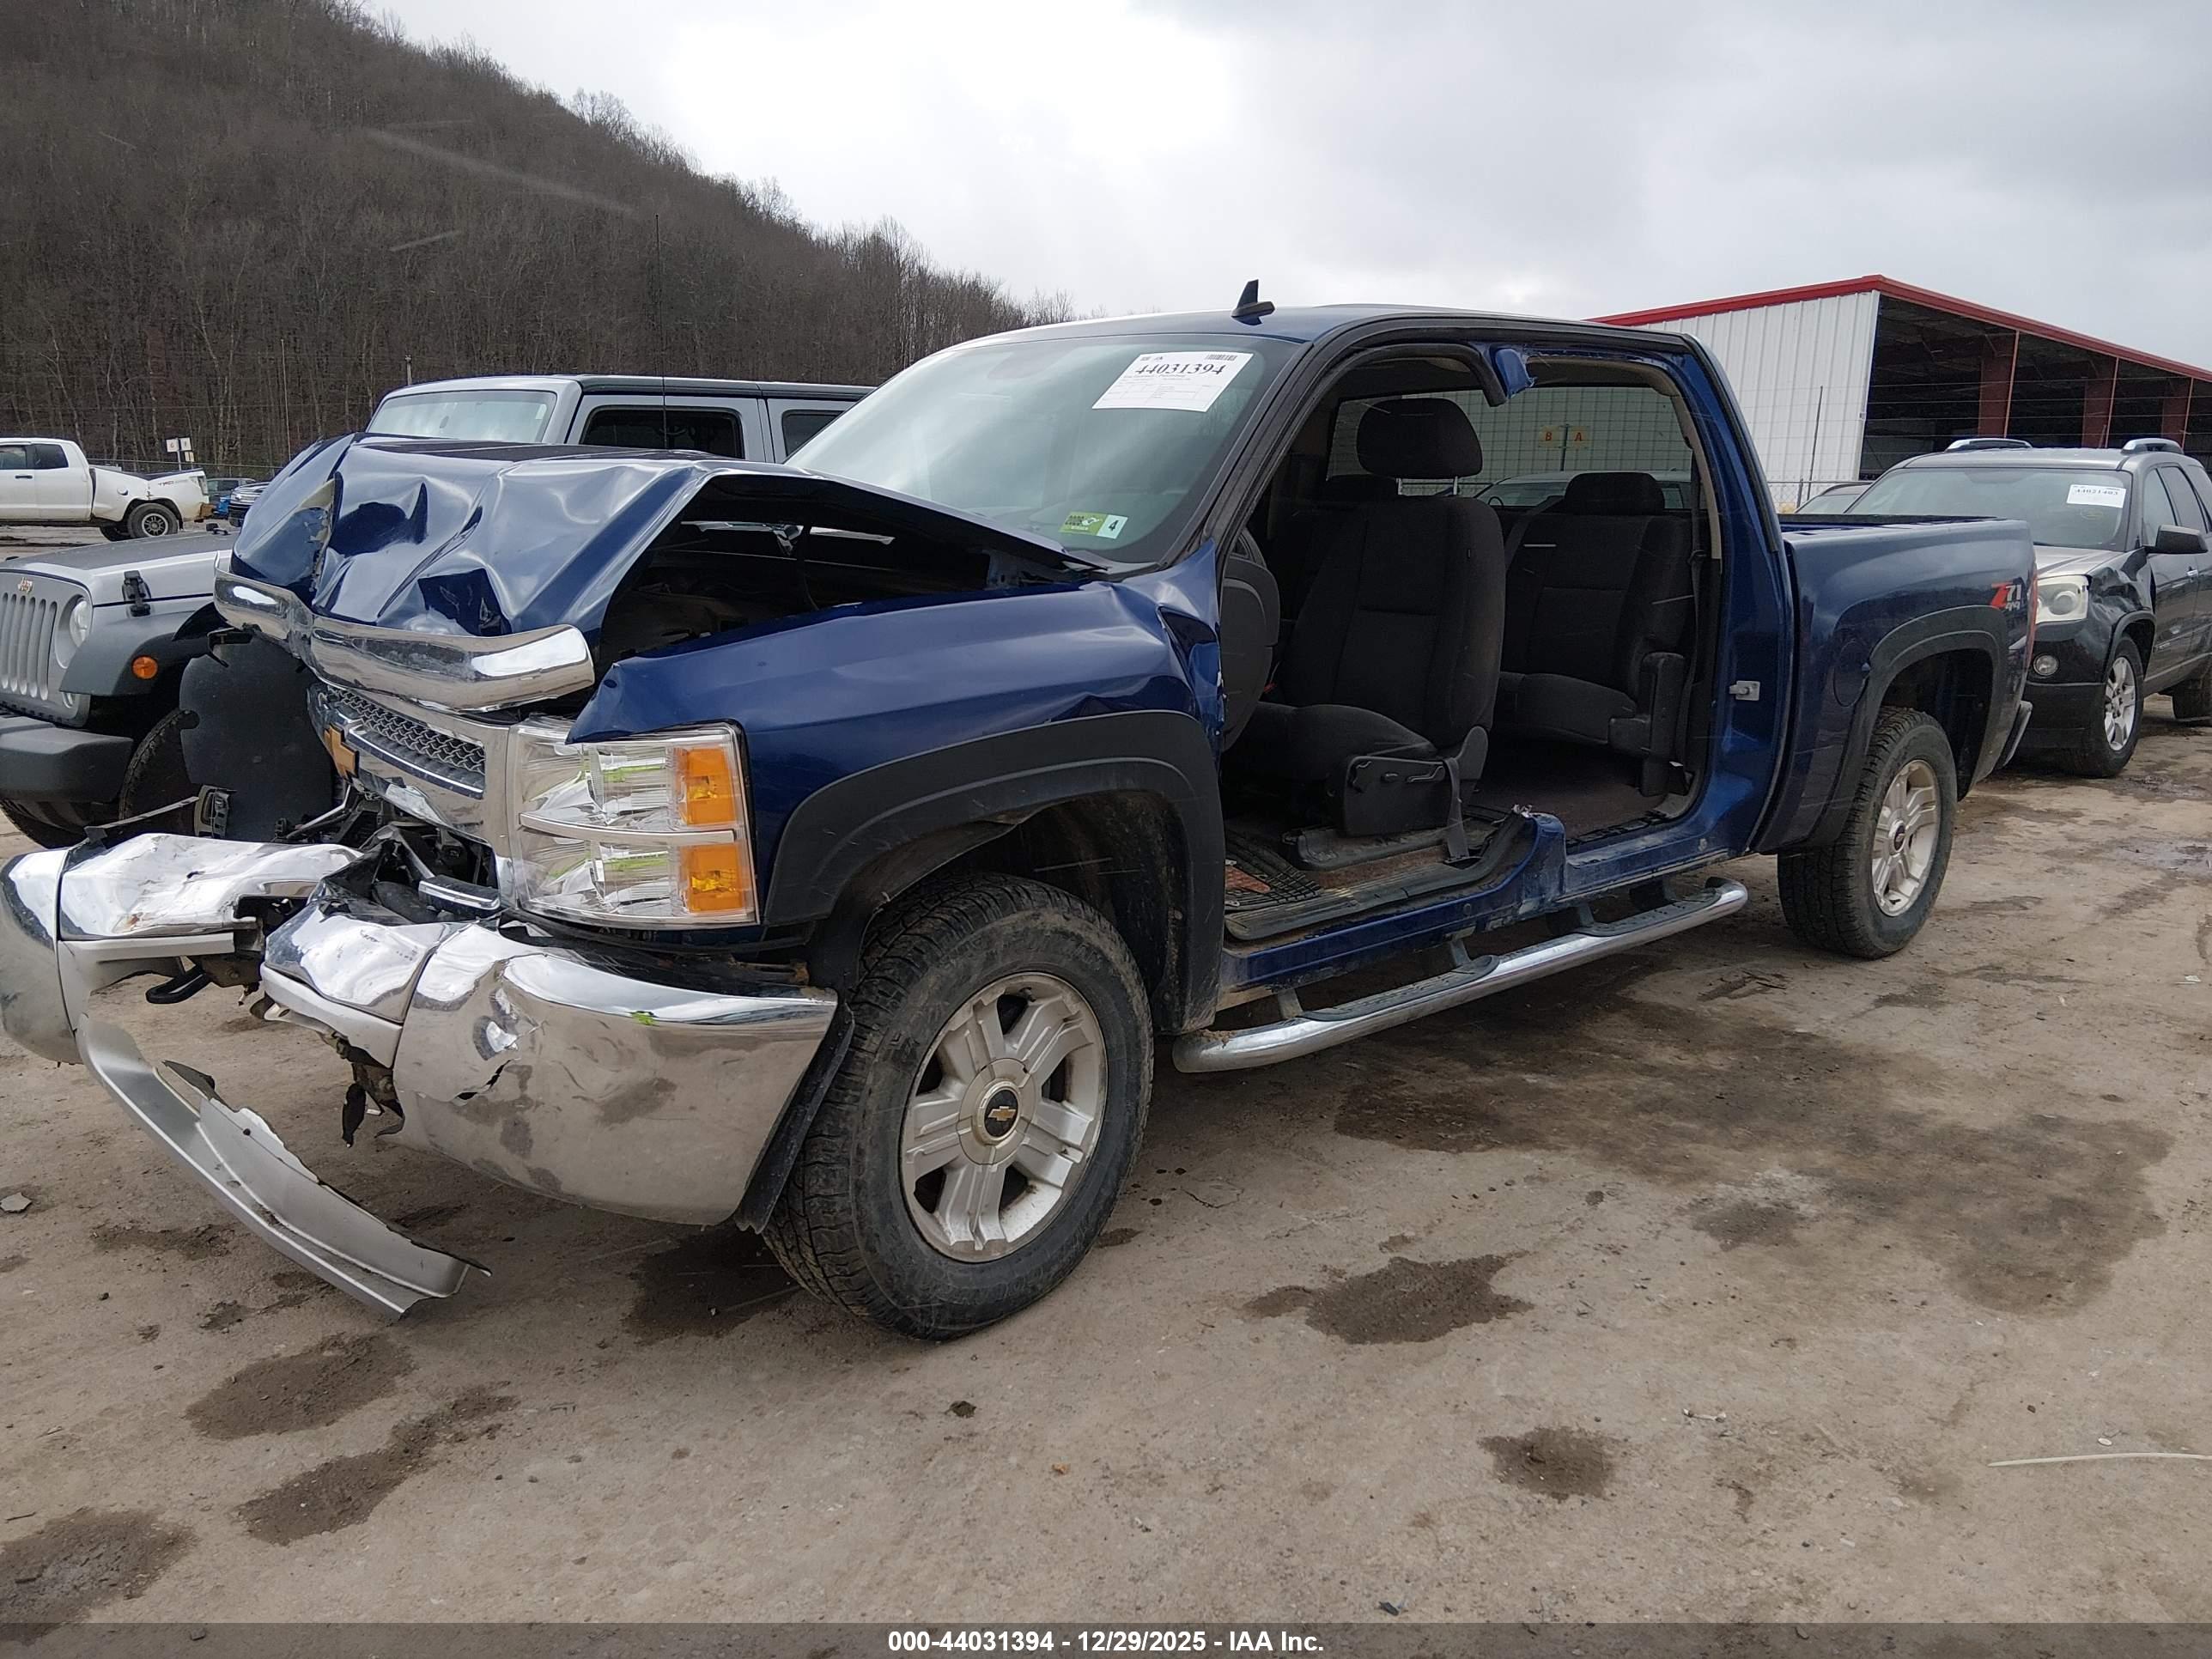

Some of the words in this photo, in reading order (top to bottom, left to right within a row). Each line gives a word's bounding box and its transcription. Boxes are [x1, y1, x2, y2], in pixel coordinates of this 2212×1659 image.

[1135, 363, 1226, 375] 44031394
[1545, 431, 1553, 441] B
[1574, 431, 1582, 441] A
[1108, 520, 1120, 532] 4
